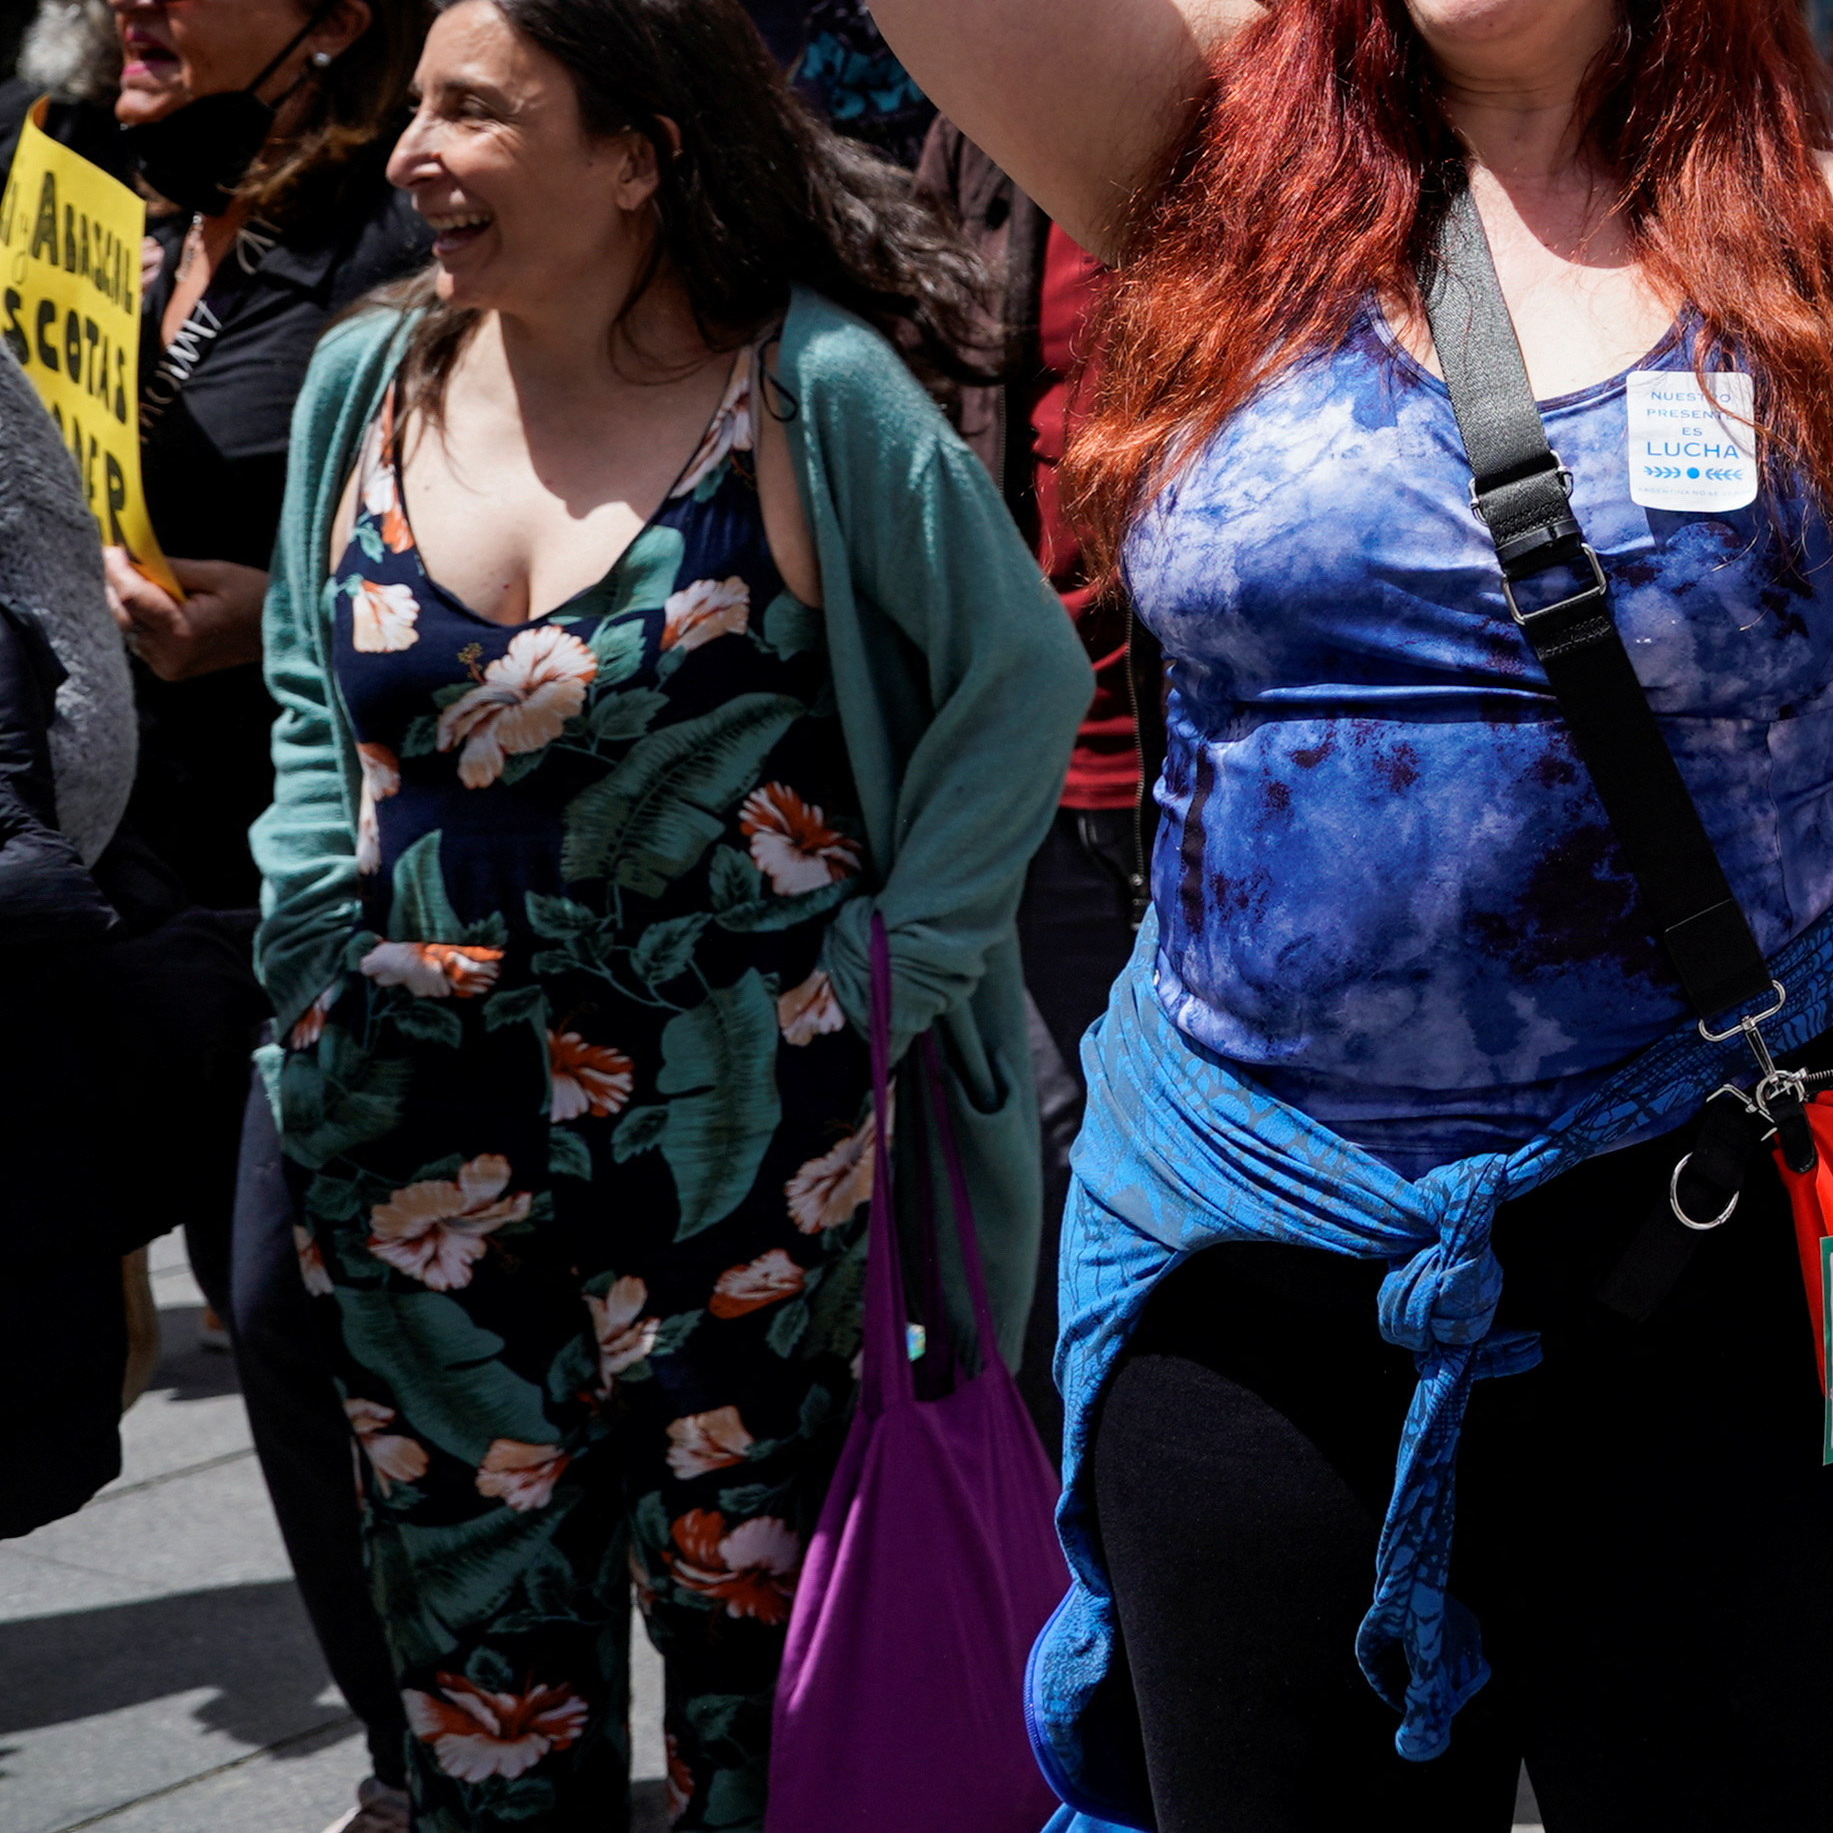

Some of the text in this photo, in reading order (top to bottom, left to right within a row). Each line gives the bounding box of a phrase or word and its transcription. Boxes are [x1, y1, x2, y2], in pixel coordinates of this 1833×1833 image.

[1651, 391, 1732, 403] NUESTO
[1682, 427, 1703, 436] ES
[1647, 441, 1740, 459] LUCHA
